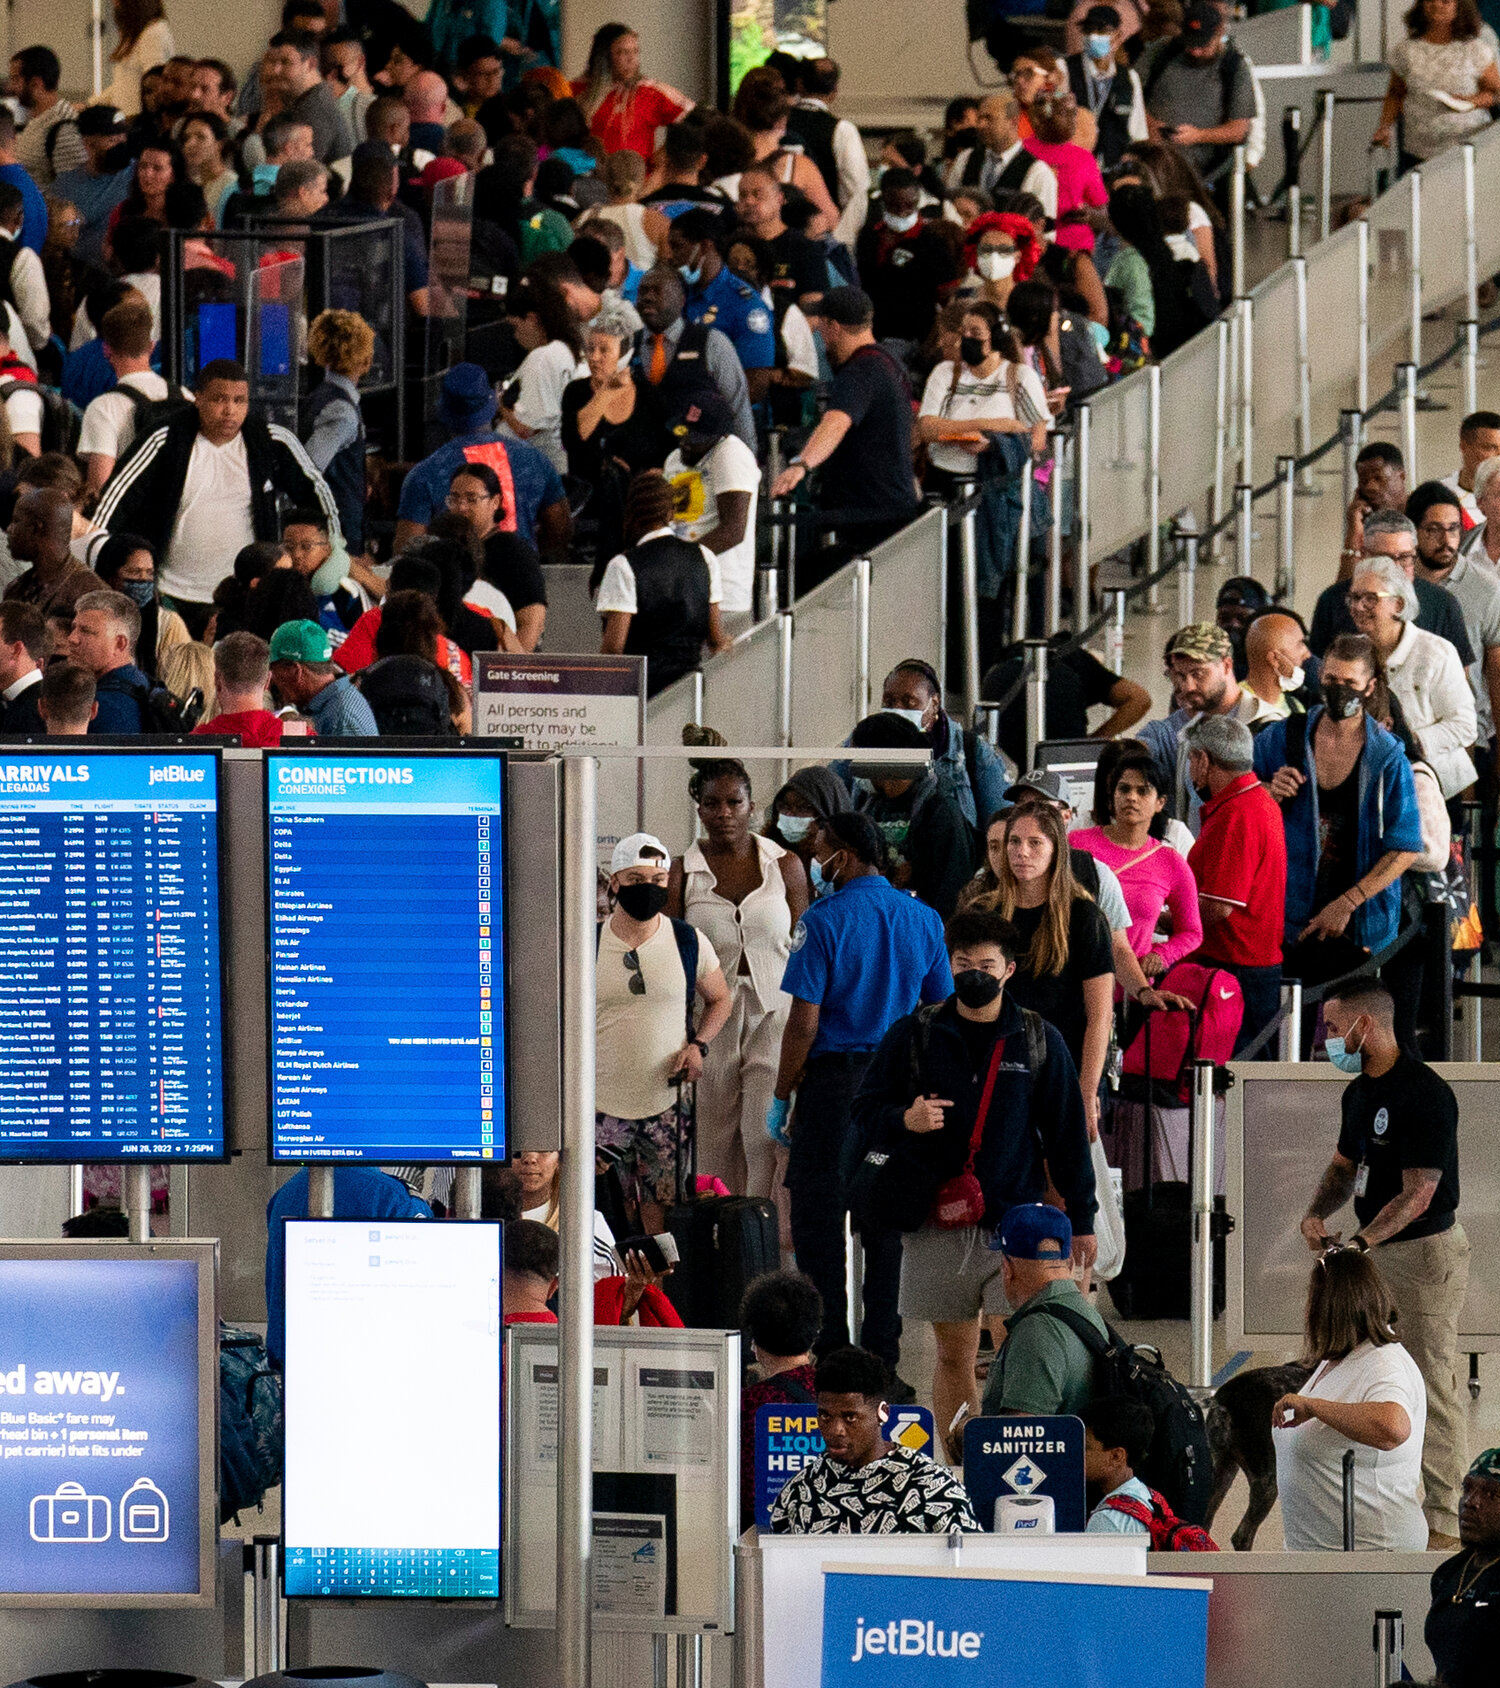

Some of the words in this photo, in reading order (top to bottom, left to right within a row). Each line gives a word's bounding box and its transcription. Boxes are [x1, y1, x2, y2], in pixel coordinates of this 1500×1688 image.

[487, 670, 510, 680] Gate
[511, 670, 560, 683] Screening
[487, 704, 504, 716] All
[508, 706, 559, 718] persons
[562, 705, 587, 718] and
[487, 722, 544, 736] property
[548, 724, 577, 737] may
[580, 723, 597, 736] be
[0, 765, 90, 782] ARRIVALS
[148, 765, 205, 785] jetBlue
[278, 767, 414, 785] CONNECTIONS
[278, 785, 347, 795] CONEXIONES
[33, 1371, 126, 1402] away.
[66, 1412, 90, 1424] fare
[90, 1415, 116, 1427] may
[768, 1416, 819, 1433] EMP
[31, 1428, 49, 1441] bin
[60, 1428, 67, 1441] 1
[69, 1428, 121, 1443] personal
[121, 1428, 149, 1441] item
[1002, 1425, 1045, 1439] HAND
[4, 1445, 23, 1459] pet
[24, 1444, 66, 1458] carrier)
[67, 1445, 91, 1457] that
[91, 1444, 110, 1457] fits
[111, 1445, 144, 1457] under
[768, 1436, 826, 1454] LIQU
[982, 1441, 1067, 1454] SANITIZER
[851, 1617, 982, 1662] jetBlue
